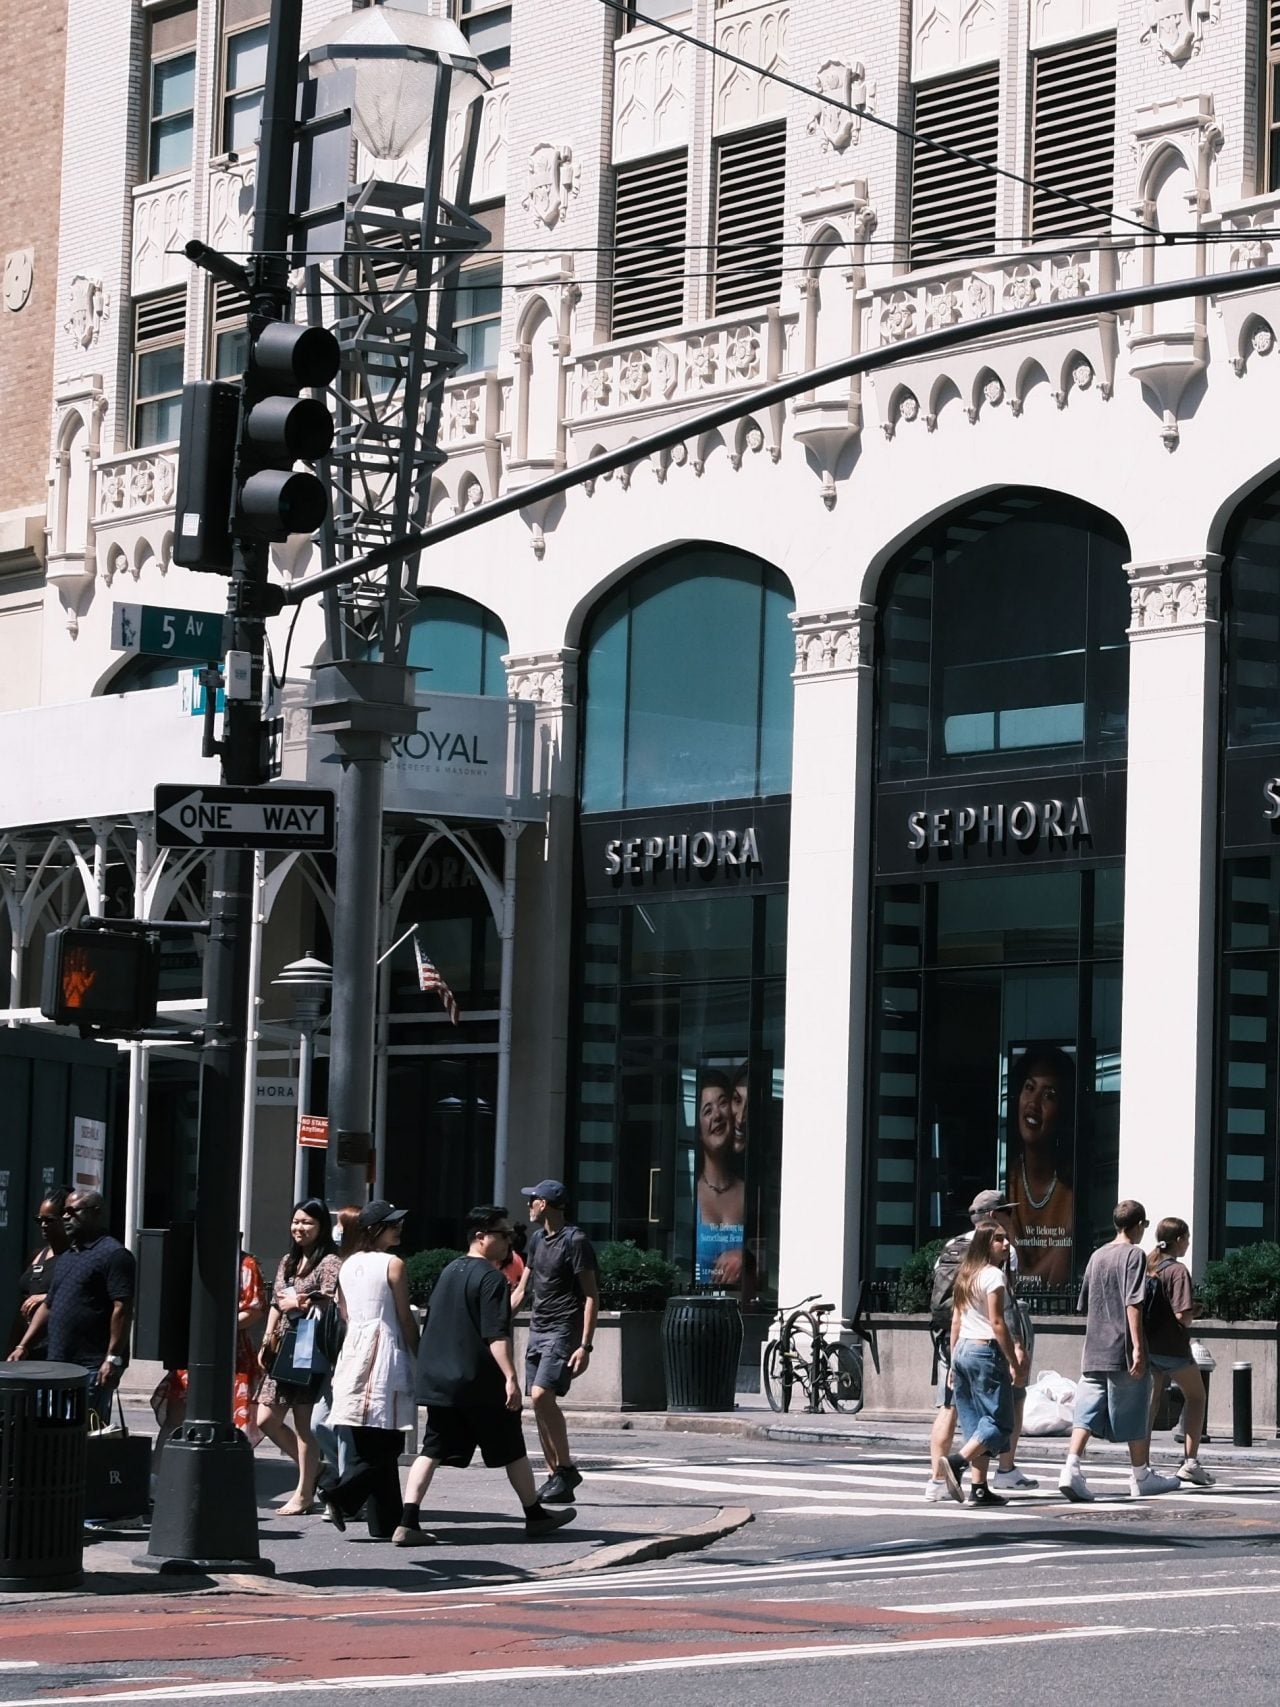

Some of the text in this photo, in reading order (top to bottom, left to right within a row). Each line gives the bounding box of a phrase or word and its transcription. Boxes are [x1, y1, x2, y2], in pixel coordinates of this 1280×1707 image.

[161, 615, 204, 649] 5 Av
[180, 805, 318, 831] ONE WAY
[907, 796, 1090, 850] SEPHORA
[604, 827, 761, 876] SEPHORA
[256, 1086, 295, 1097] HORA
[709, 1222, 718, 1231] We
[1025, 1225, 1065, 1236] We Belong to
[1014, 1236, 1047, 1248] Something
